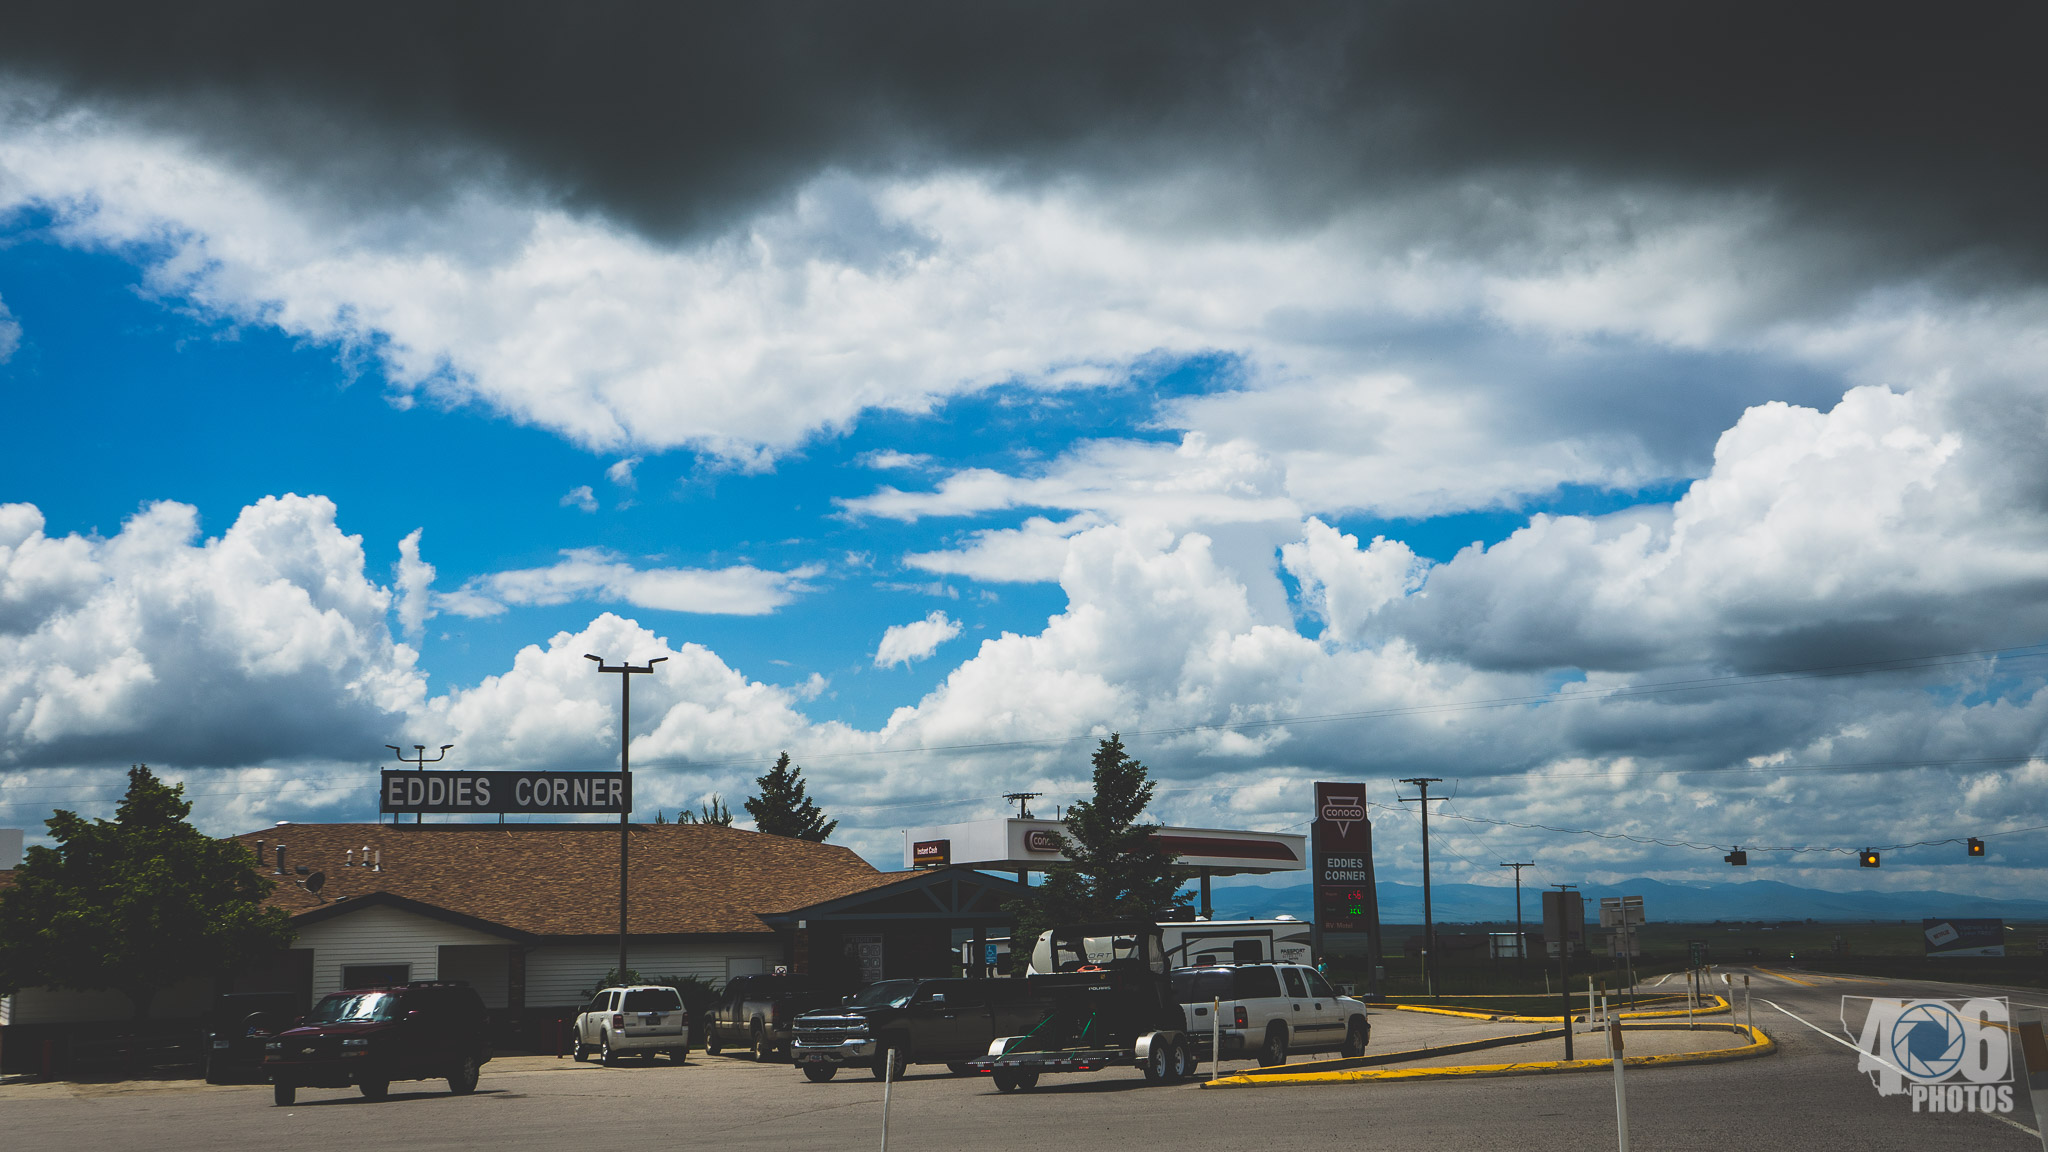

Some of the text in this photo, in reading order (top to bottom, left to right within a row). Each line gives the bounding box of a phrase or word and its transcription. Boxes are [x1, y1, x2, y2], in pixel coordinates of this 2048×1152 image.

[388, 777, 623, 807] EDDIES CORNER
[1327, 858, 1363, 869] EDDIES
[1325, 870, 1366, 881] CORNER
